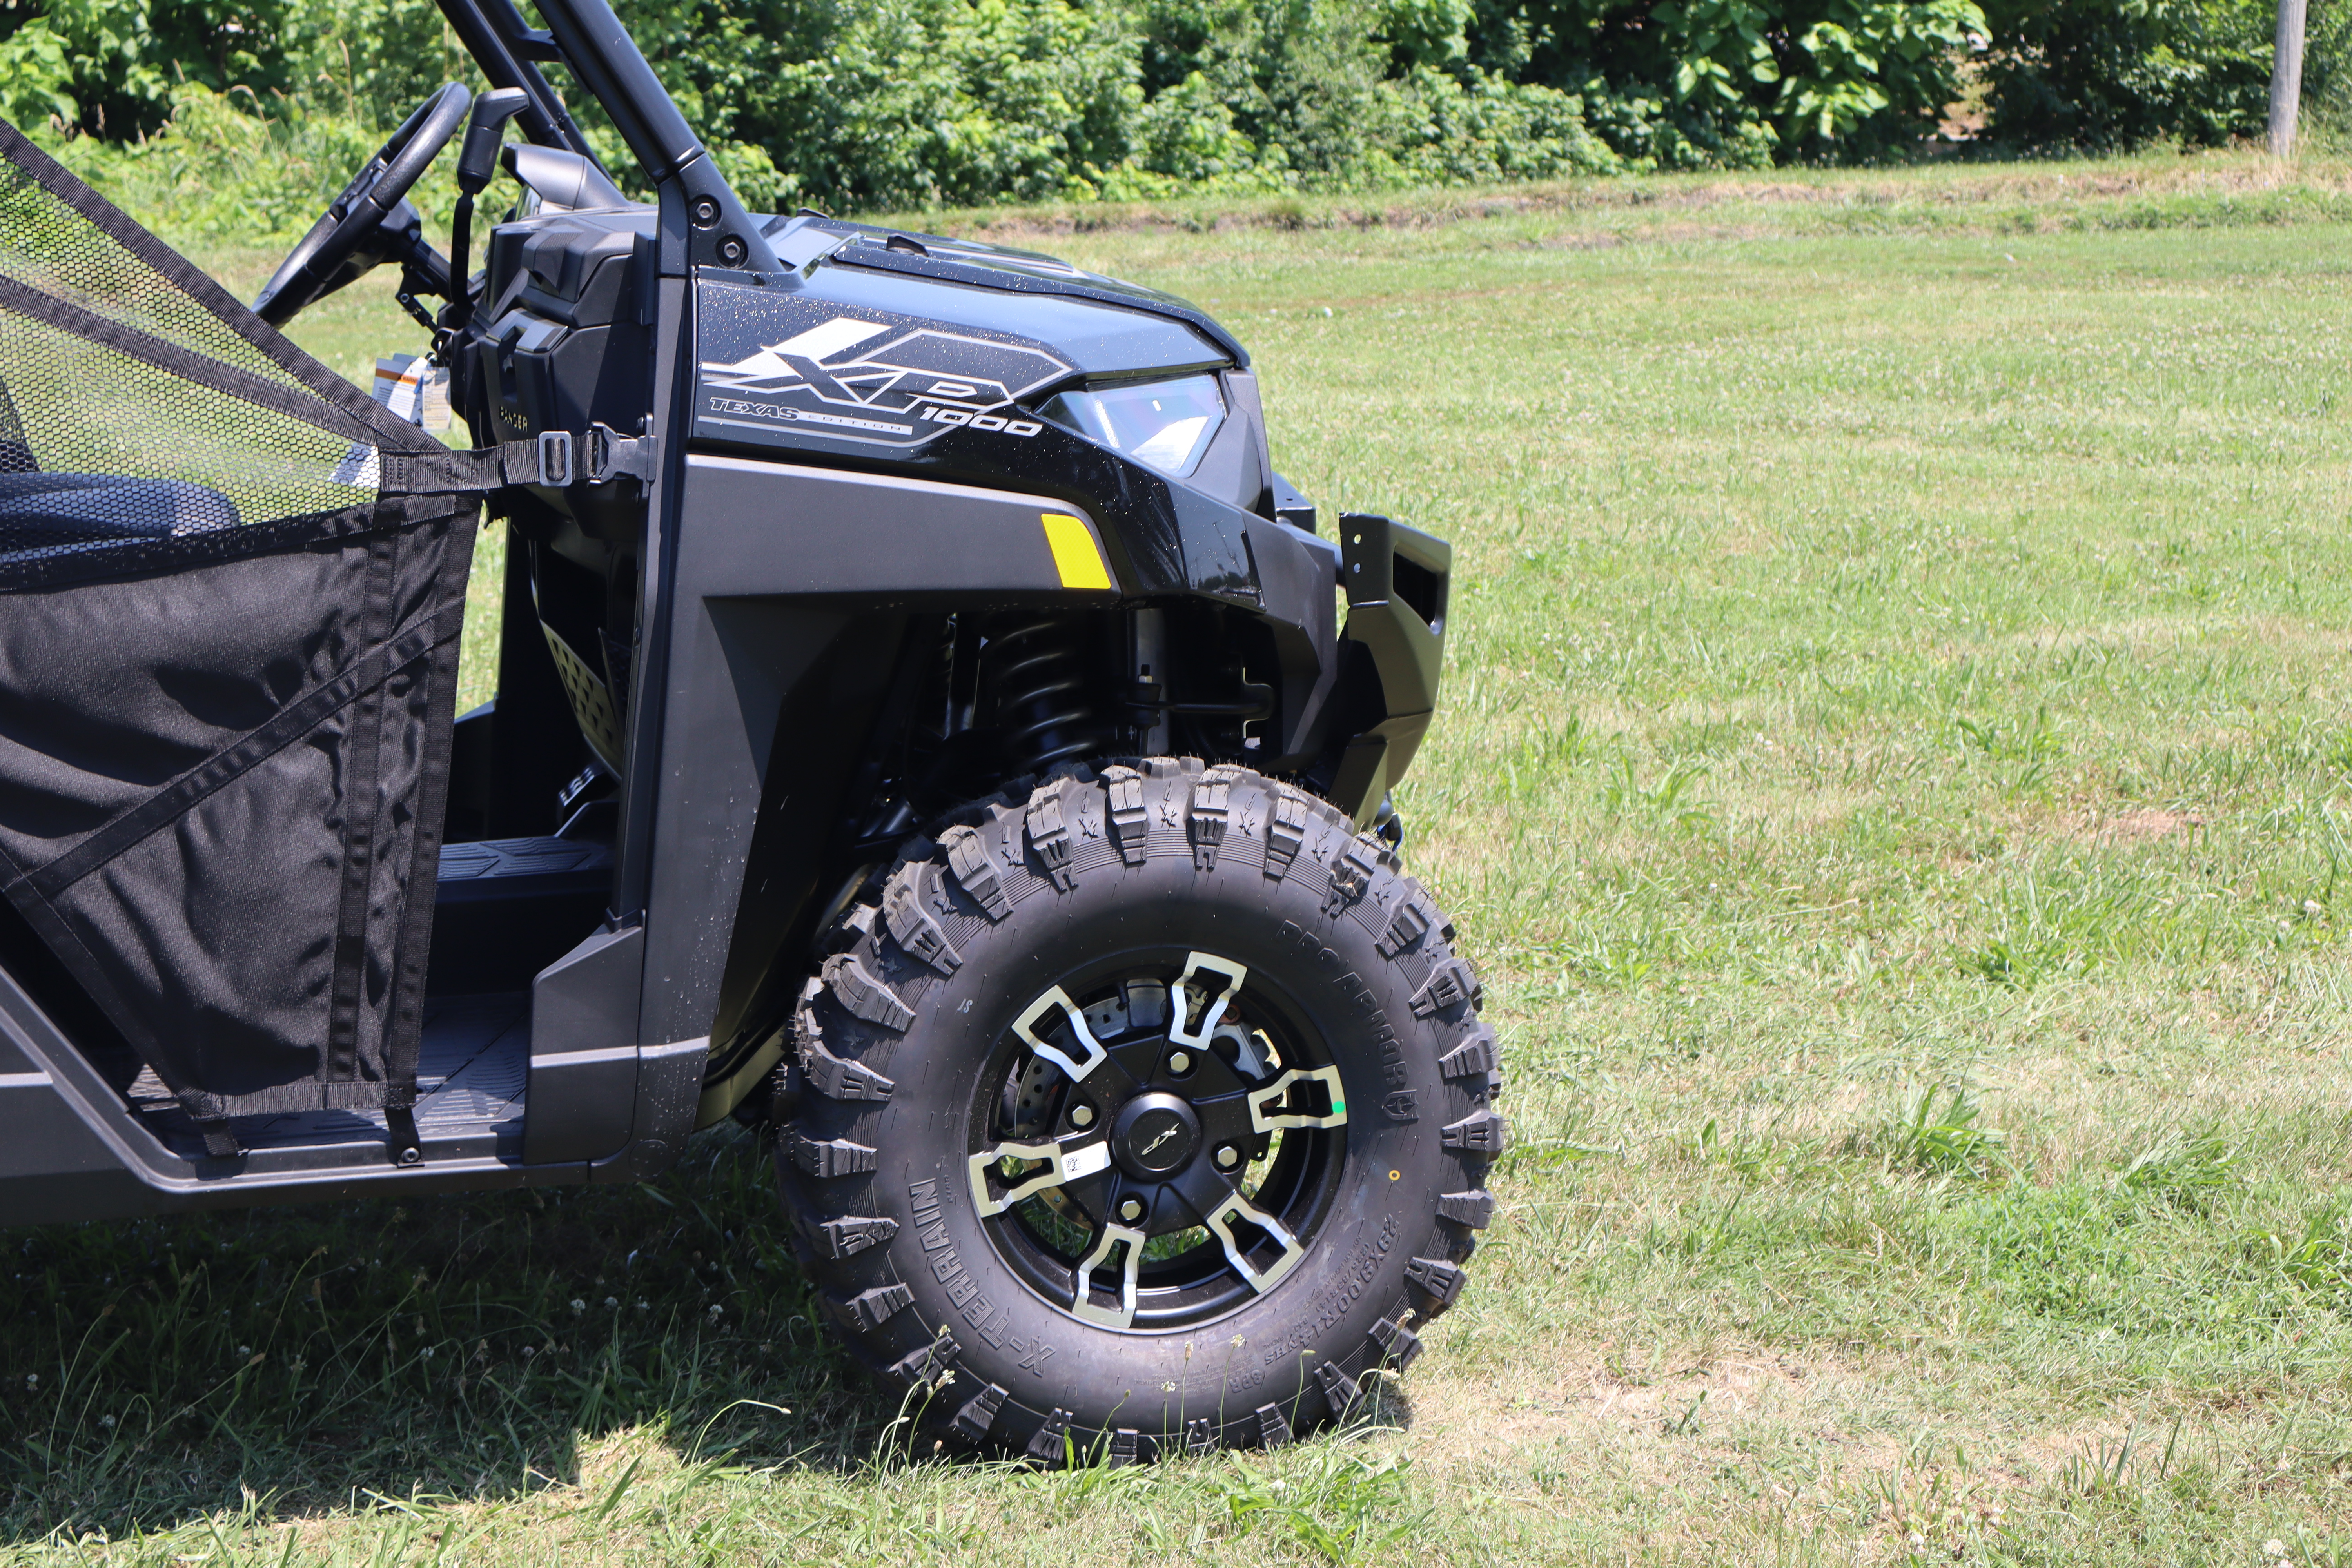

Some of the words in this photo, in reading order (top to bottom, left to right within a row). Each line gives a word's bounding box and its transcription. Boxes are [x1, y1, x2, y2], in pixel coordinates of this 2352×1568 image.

[701, 317, 1014, 414] XP
[710, 397, 799, 421] TEXAS
[808, 414, 900, 431] EDITION
[920, 405, 1043, 437] 1000
[1276, 918, 1340, 967] PRO
[1333, 971, 1409, 1086] ARMOR
[909, 1177, 1056, 1378] X-TERRAIN
[1227, 1368, 1265, 1393] 8PR
